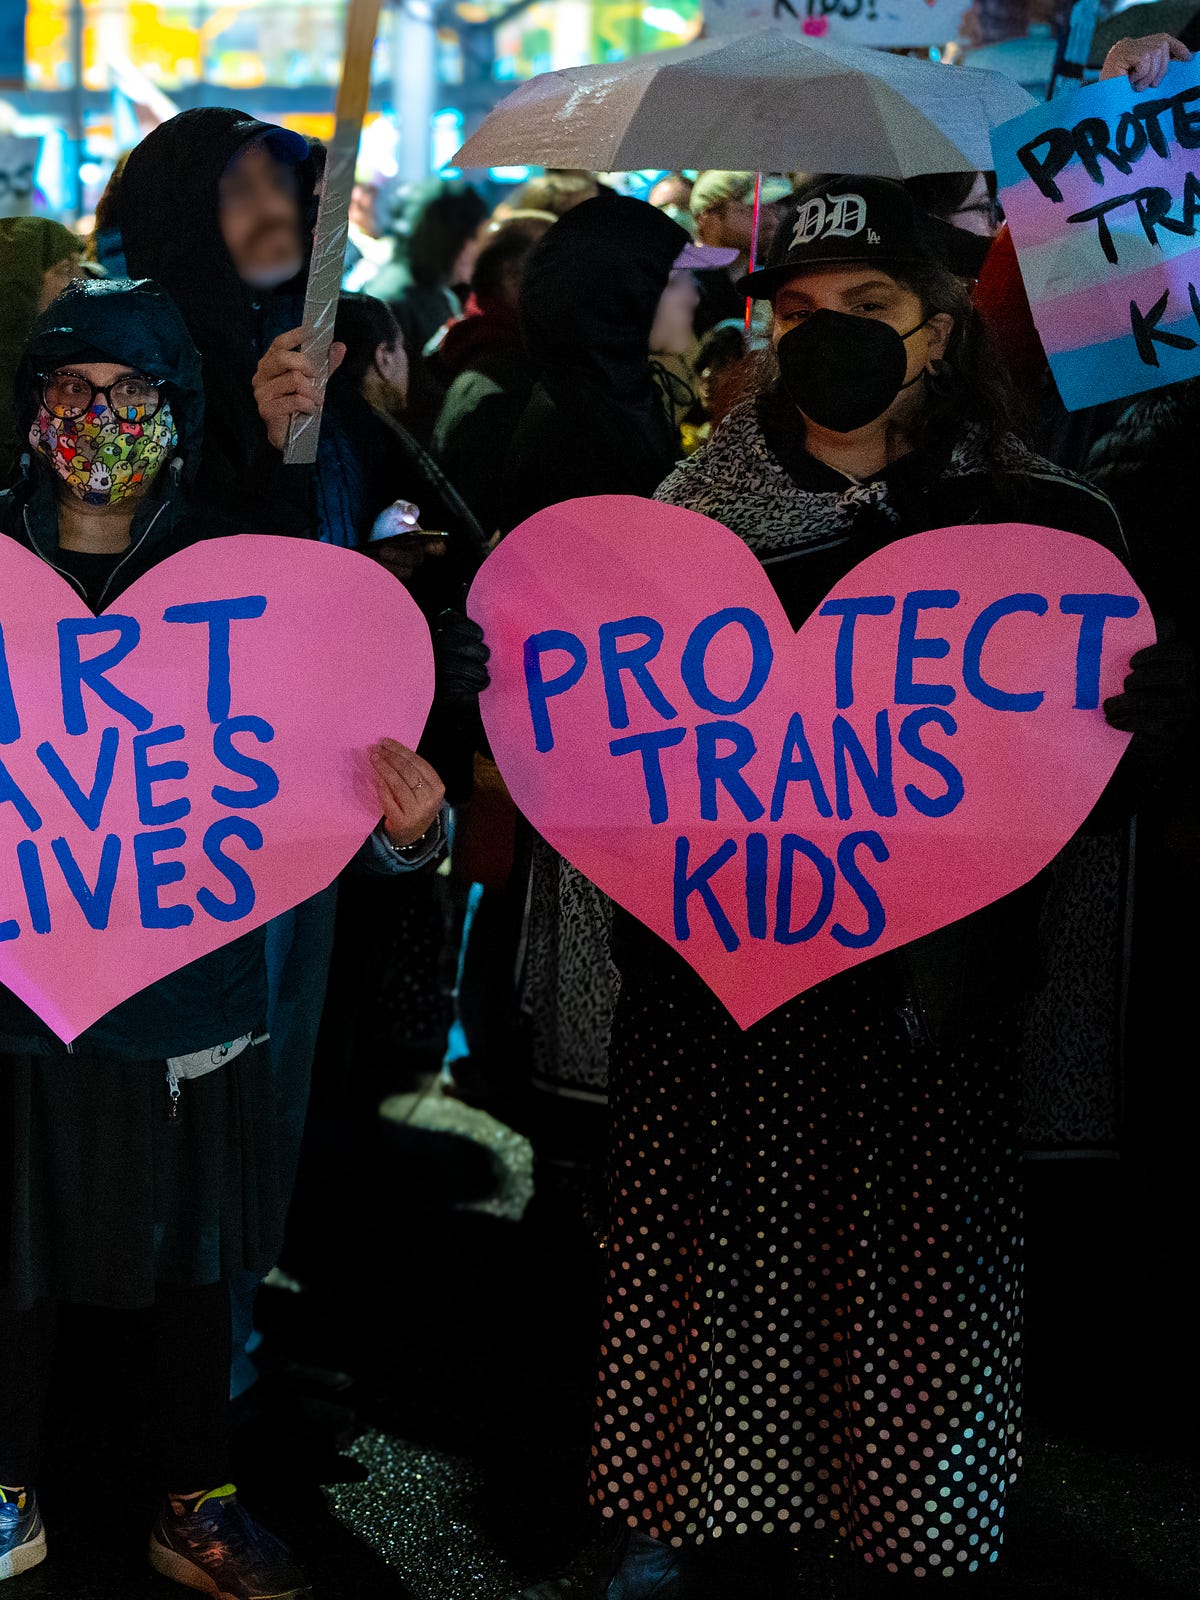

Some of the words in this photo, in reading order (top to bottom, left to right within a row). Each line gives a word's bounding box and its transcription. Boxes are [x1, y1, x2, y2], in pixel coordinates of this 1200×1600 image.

[866, 228, 880, 244] LA
[523, 590, 1140, 754] PROTECT
[609, 706, 965, 824] TRANS
[673, 831, 890, 952] KIDS
